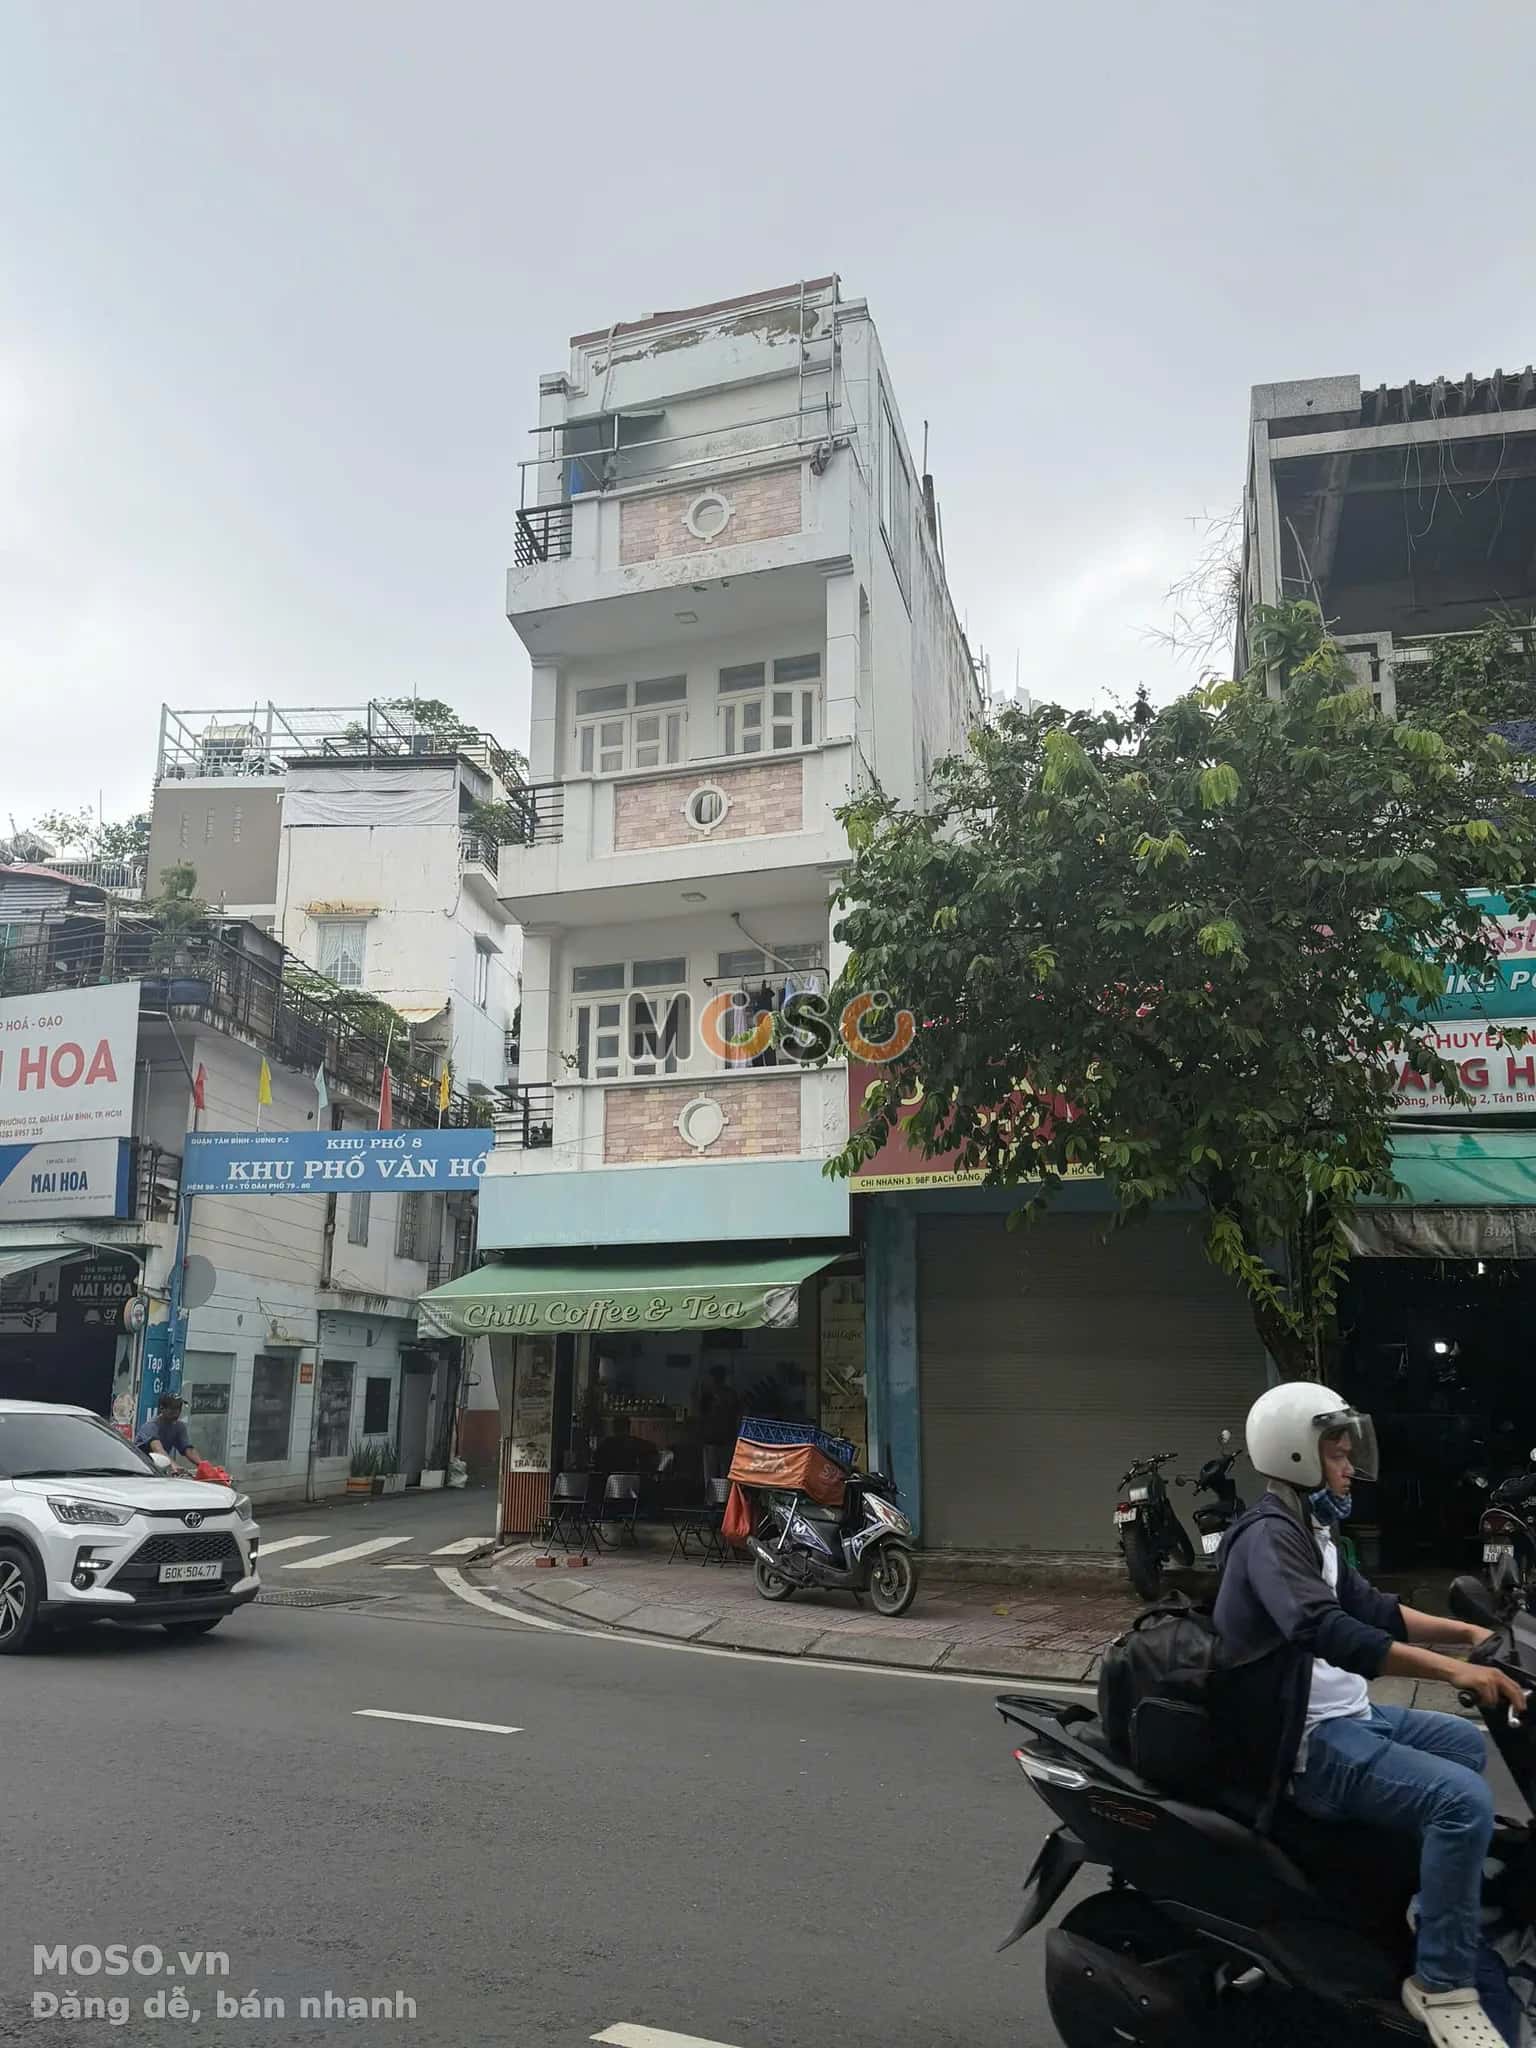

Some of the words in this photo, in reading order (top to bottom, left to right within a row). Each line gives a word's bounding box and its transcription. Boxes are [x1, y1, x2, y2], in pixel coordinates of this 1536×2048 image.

[1445, 971, 1495, 994] IKE
[18, 1039, 118, 1091] HOA
[327, 1139, 364, 1149] KHU
[370, 1134, 406, 1148] PHỐ
[412, 1138, 422, 1148] 8
[228, 1161, 295, 1180] KHU
[304, 1152, 367, 1179] PHỐ
[376, 1154, 438, 1178] VĂN
[31, 1173, 56, 1193] MAI
[60, 1171, 88, 1191] HOA
[72, 1283, 98, 1297] MAI
[103, 1282, 133, 1297] HOA
[463, 1302, 537, 1327] Chill
[544, 1298, 640, 1330] Coffee
[645, 1297, 672, 1322] &
[682, 1294, 746, 1320] Tea
